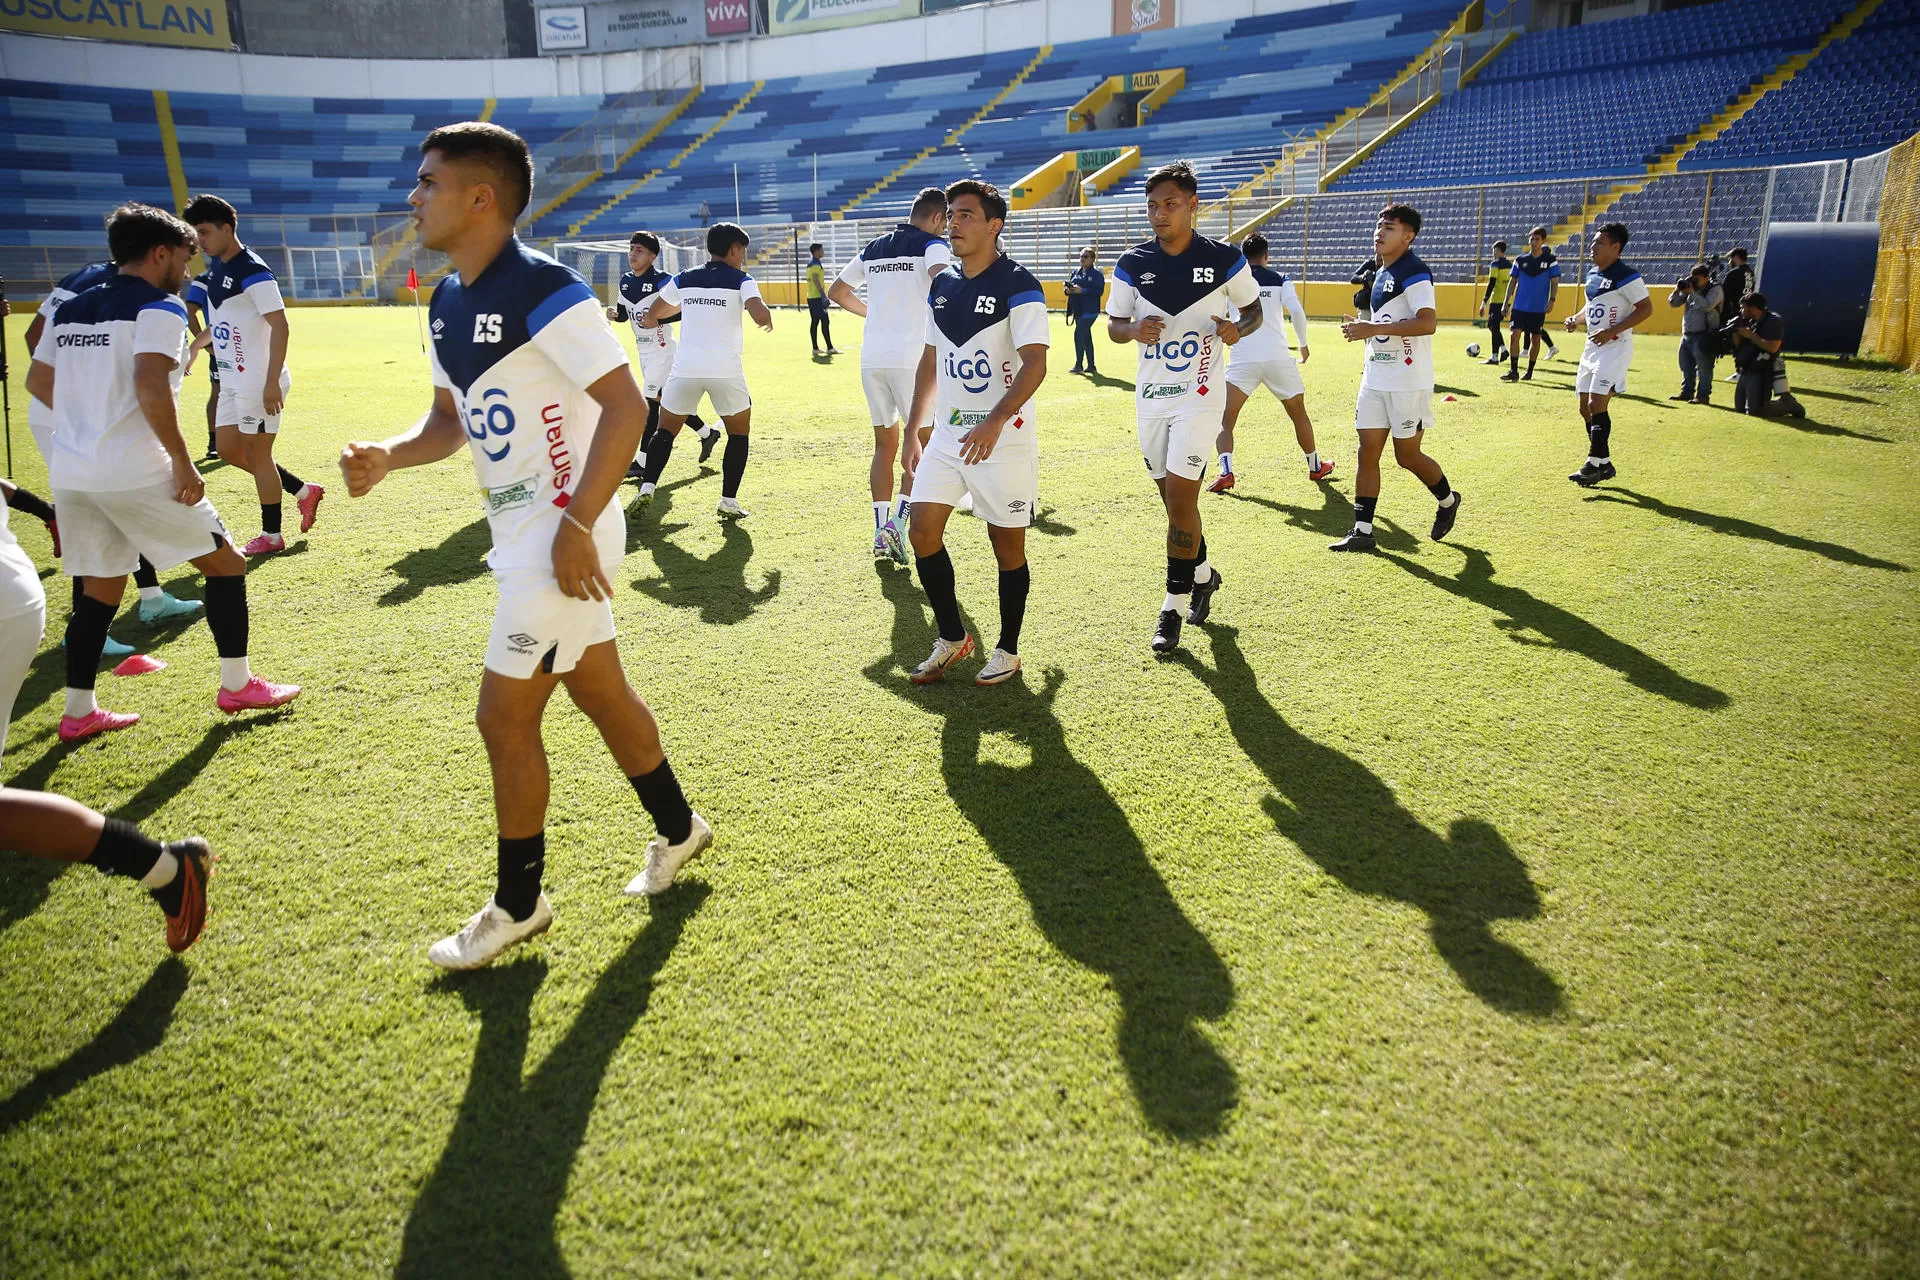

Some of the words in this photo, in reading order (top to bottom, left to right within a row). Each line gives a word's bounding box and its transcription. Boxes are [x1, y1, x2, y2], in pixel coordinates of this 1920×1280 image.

[619, 10, 671, 21] MONUMENTAL
[608, 20, 640, 32] ESTADIO
[1128, 74, 1160, 88] SALIDA
[869, 263, 914, 273] POWERADE
[1193, 268, 1214, 283] ES
[642, 283, 653, 292] ES
[684, 298, 727, 307] POWERADE
[974, 296, 996, 314] ES
[473, 314, 503, 343] ES
[541, 403, 571, 490] siman
